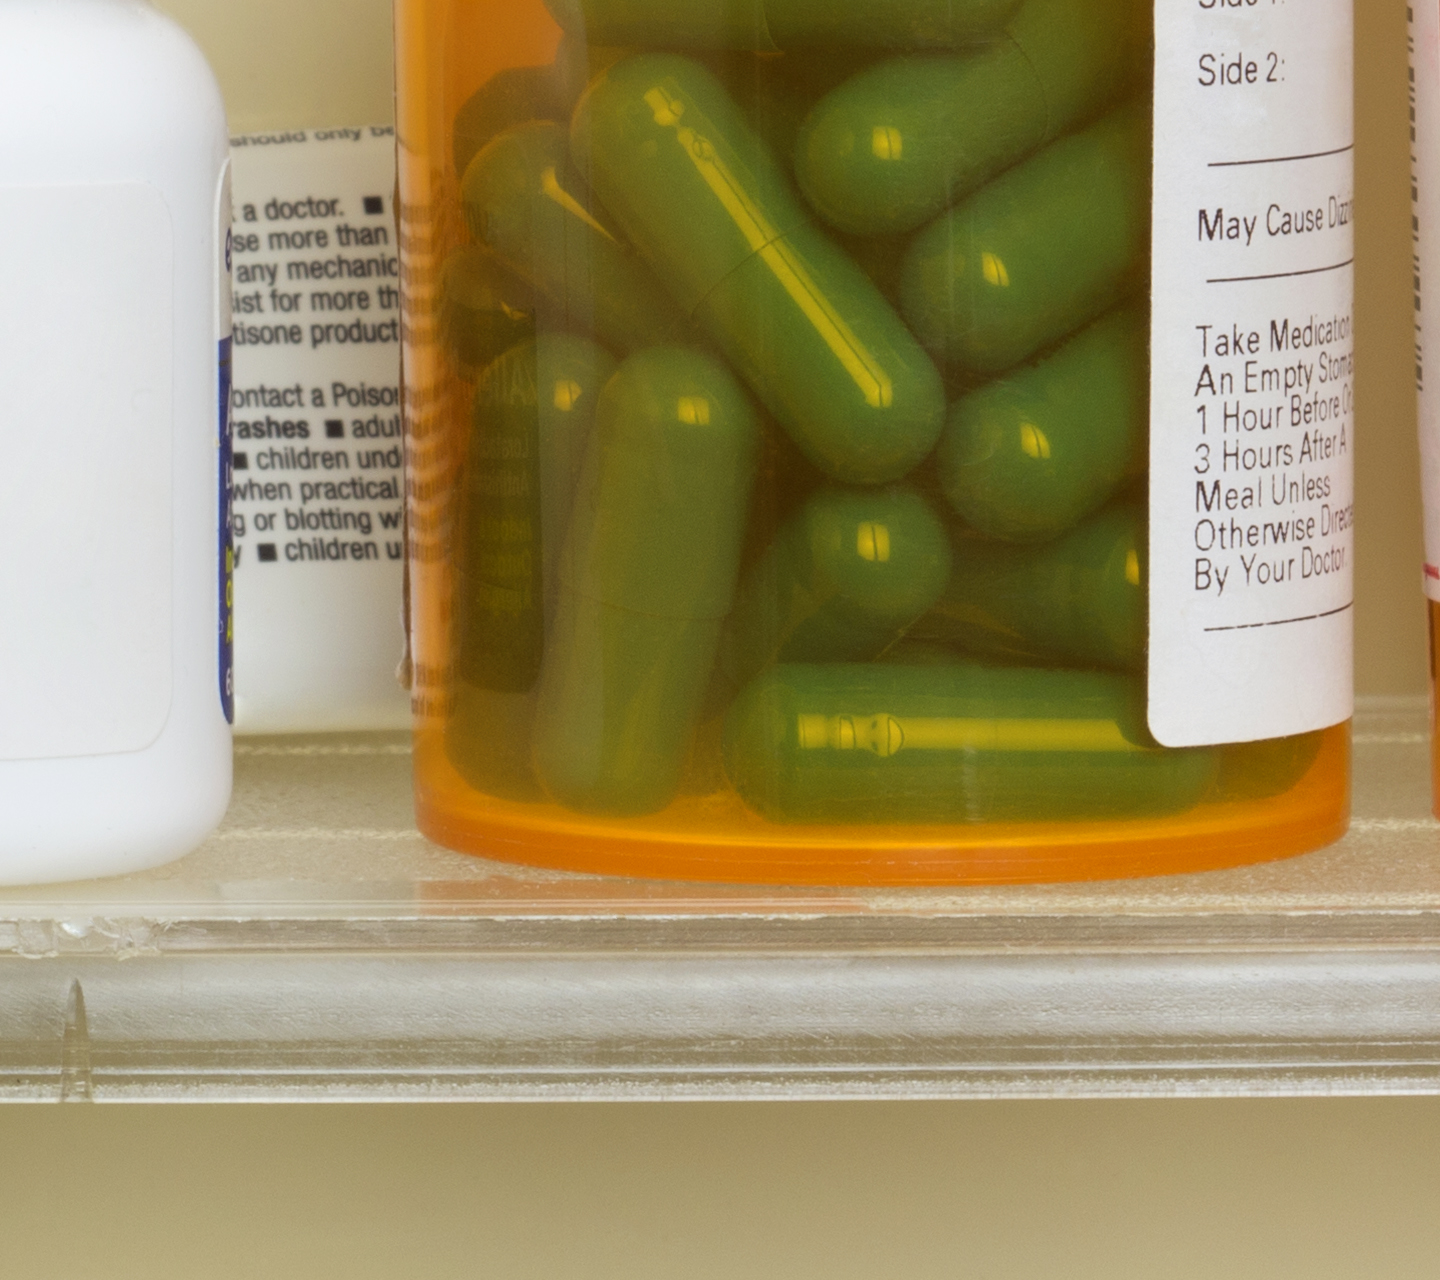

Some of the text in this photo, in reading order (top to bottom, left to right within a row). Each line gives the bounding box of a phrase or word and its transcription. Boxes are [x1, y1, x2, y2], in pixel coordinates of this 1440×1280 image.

[1198, 52, 1284, 86] Side 2:
[315, 127, 361, 143] only
[265, 197, 344, 220] doctor.
[268, 229, 328, 250] more
[336, 223, 388, 246] than
[1198, 208, 1257, 246] May
[1266, 204, 1323, 236] Cause
[237, 263, 277, 286] any
[270, 287, 302, 312] for
[311, 290, 369, 310] more
[1195, 314, 1350, 357] Take Medication
[1194, 364, 1233, 397] An
[1245, 360, 1313, 397] Empty
[311, 388, 325, 407] a
[1197, 405, 1206, 435] 1
[1223, 400, 1283, 433] Hour
[1291, 391, 1339, 427] Before
[256, 446, 349, 470] children
[1194, 428, 1348, 474] 3 Hours After A
[1196, 473, 1330, 513] Meal Unless
[254, 513, 276, 531] or
[285, 507, 372, 534] blotting
[1195, 517, 1315, 551] Otherwise
[285, 538, 378, 561] children
[1195, 558, 1229, 596] By
[1240, 553, 1295, 584] Your
